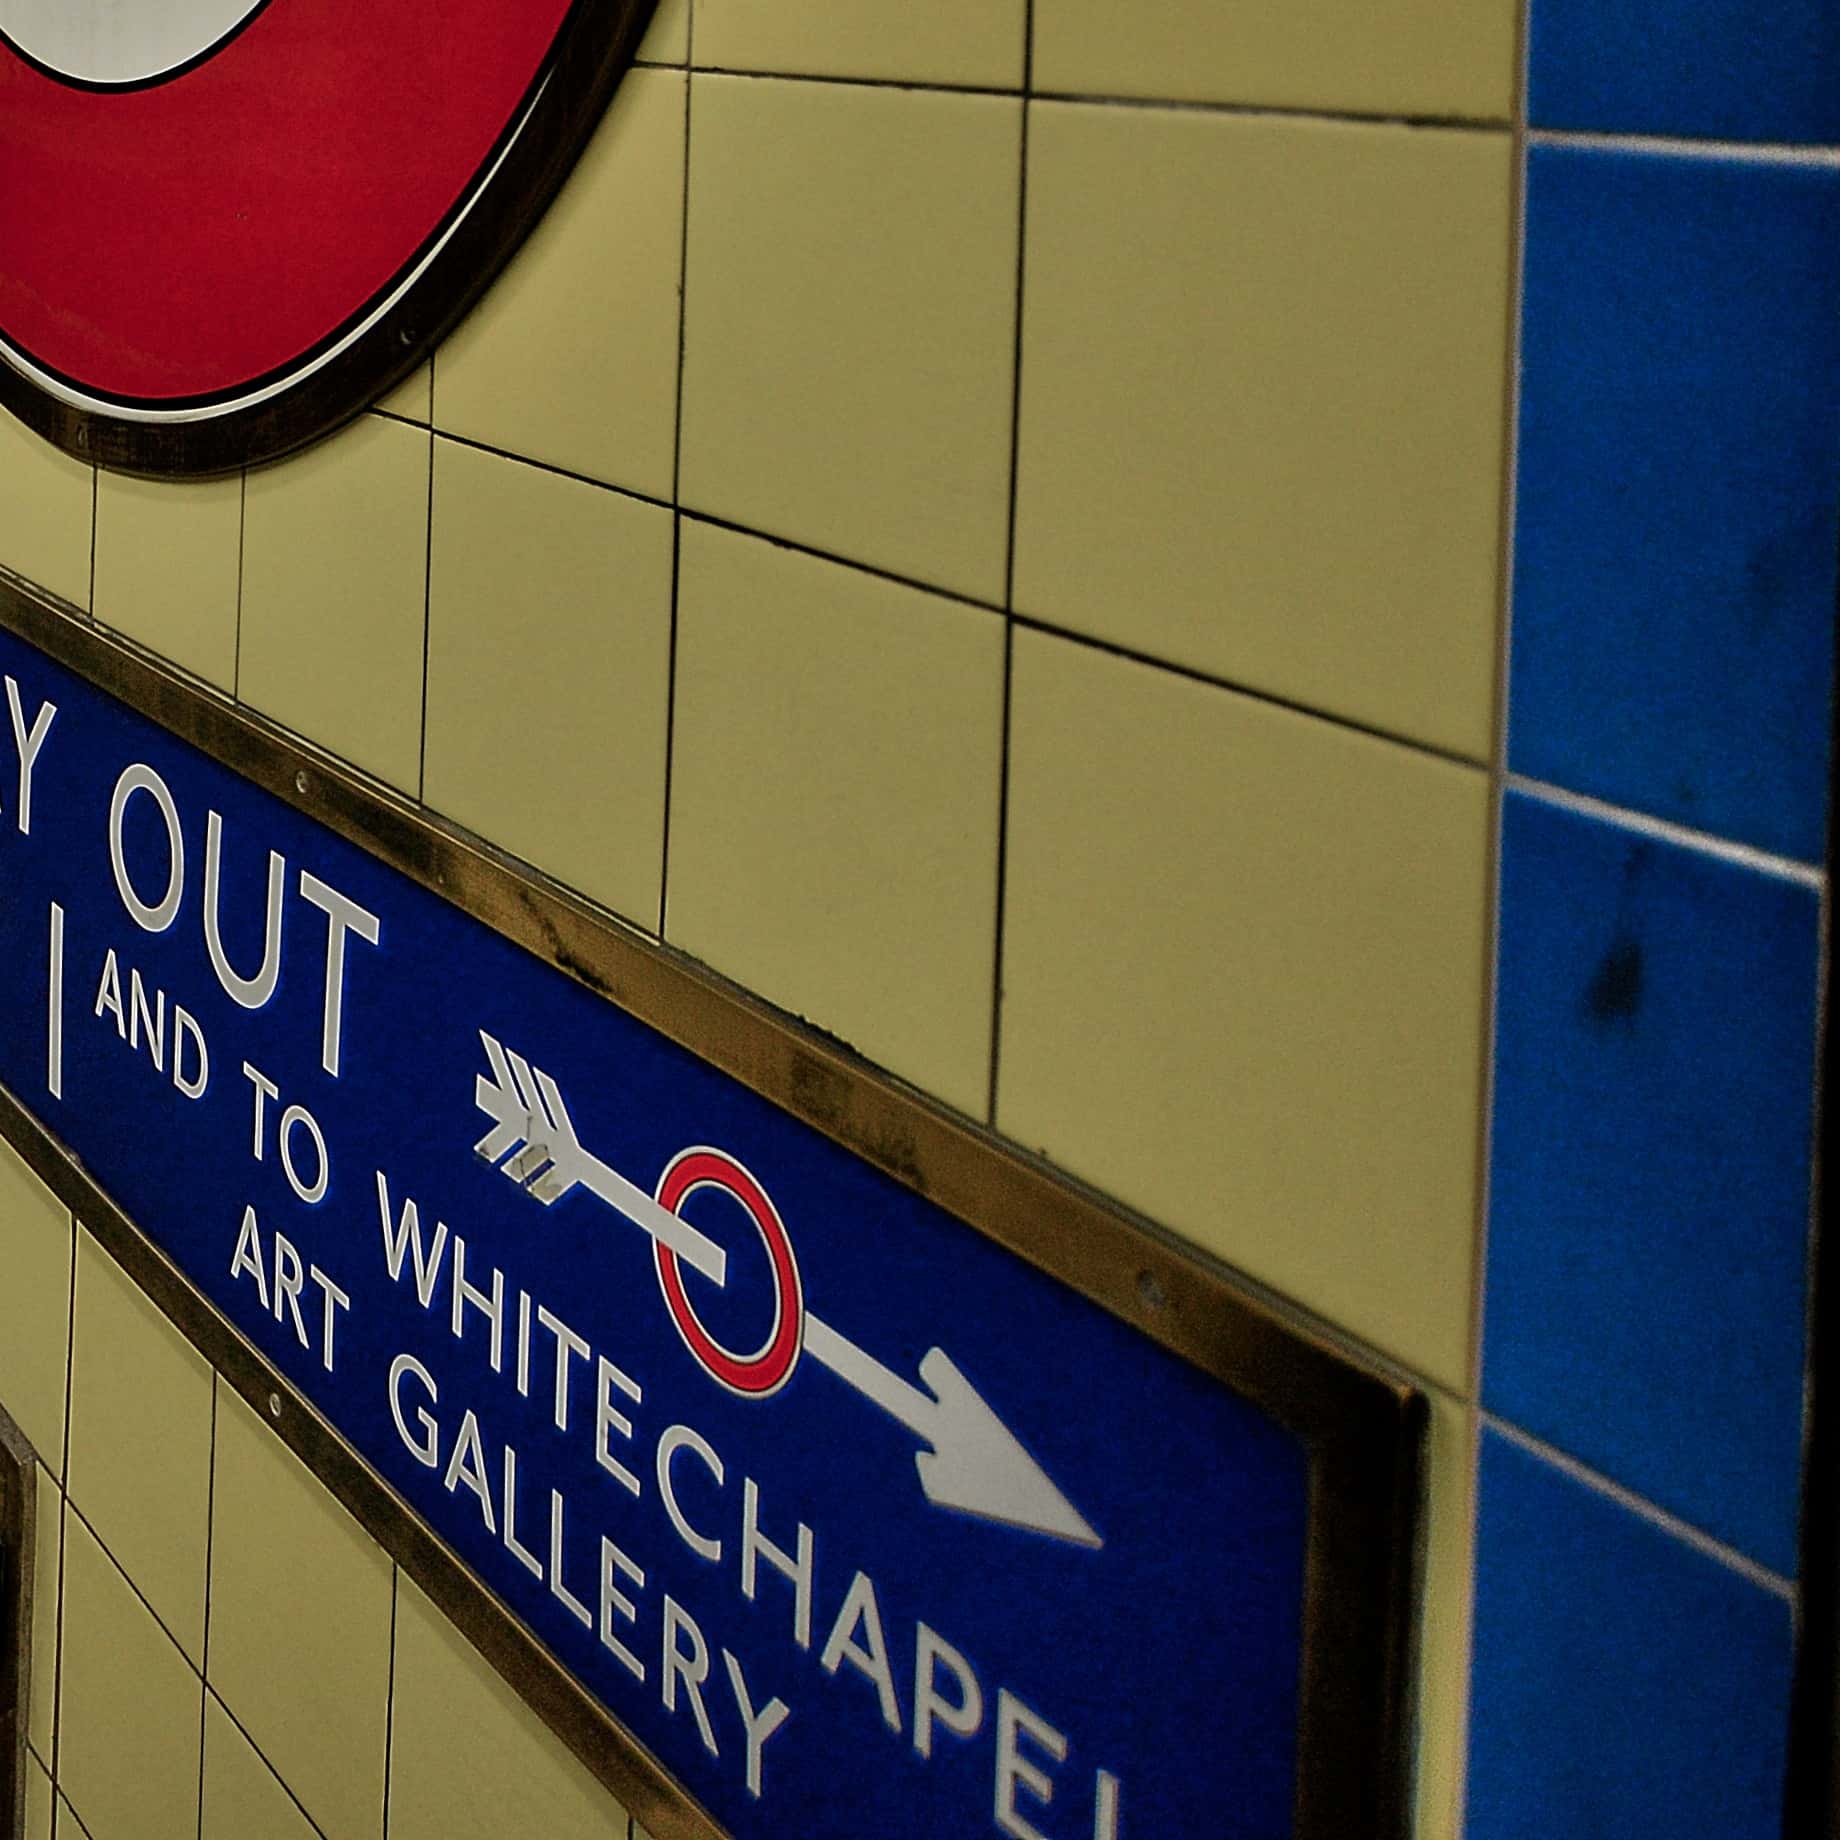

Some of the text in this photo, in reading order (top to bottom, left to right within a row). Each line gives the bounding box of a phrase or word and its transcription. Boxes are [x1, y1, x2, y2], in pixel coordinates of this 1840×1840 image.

[94, 948, 209, 1100] AND
[243, 1060, 329, 1204] TO
[109, 763, 380, 1079] OUT
[230, 1204, 790, 1797] ART GALLERY
